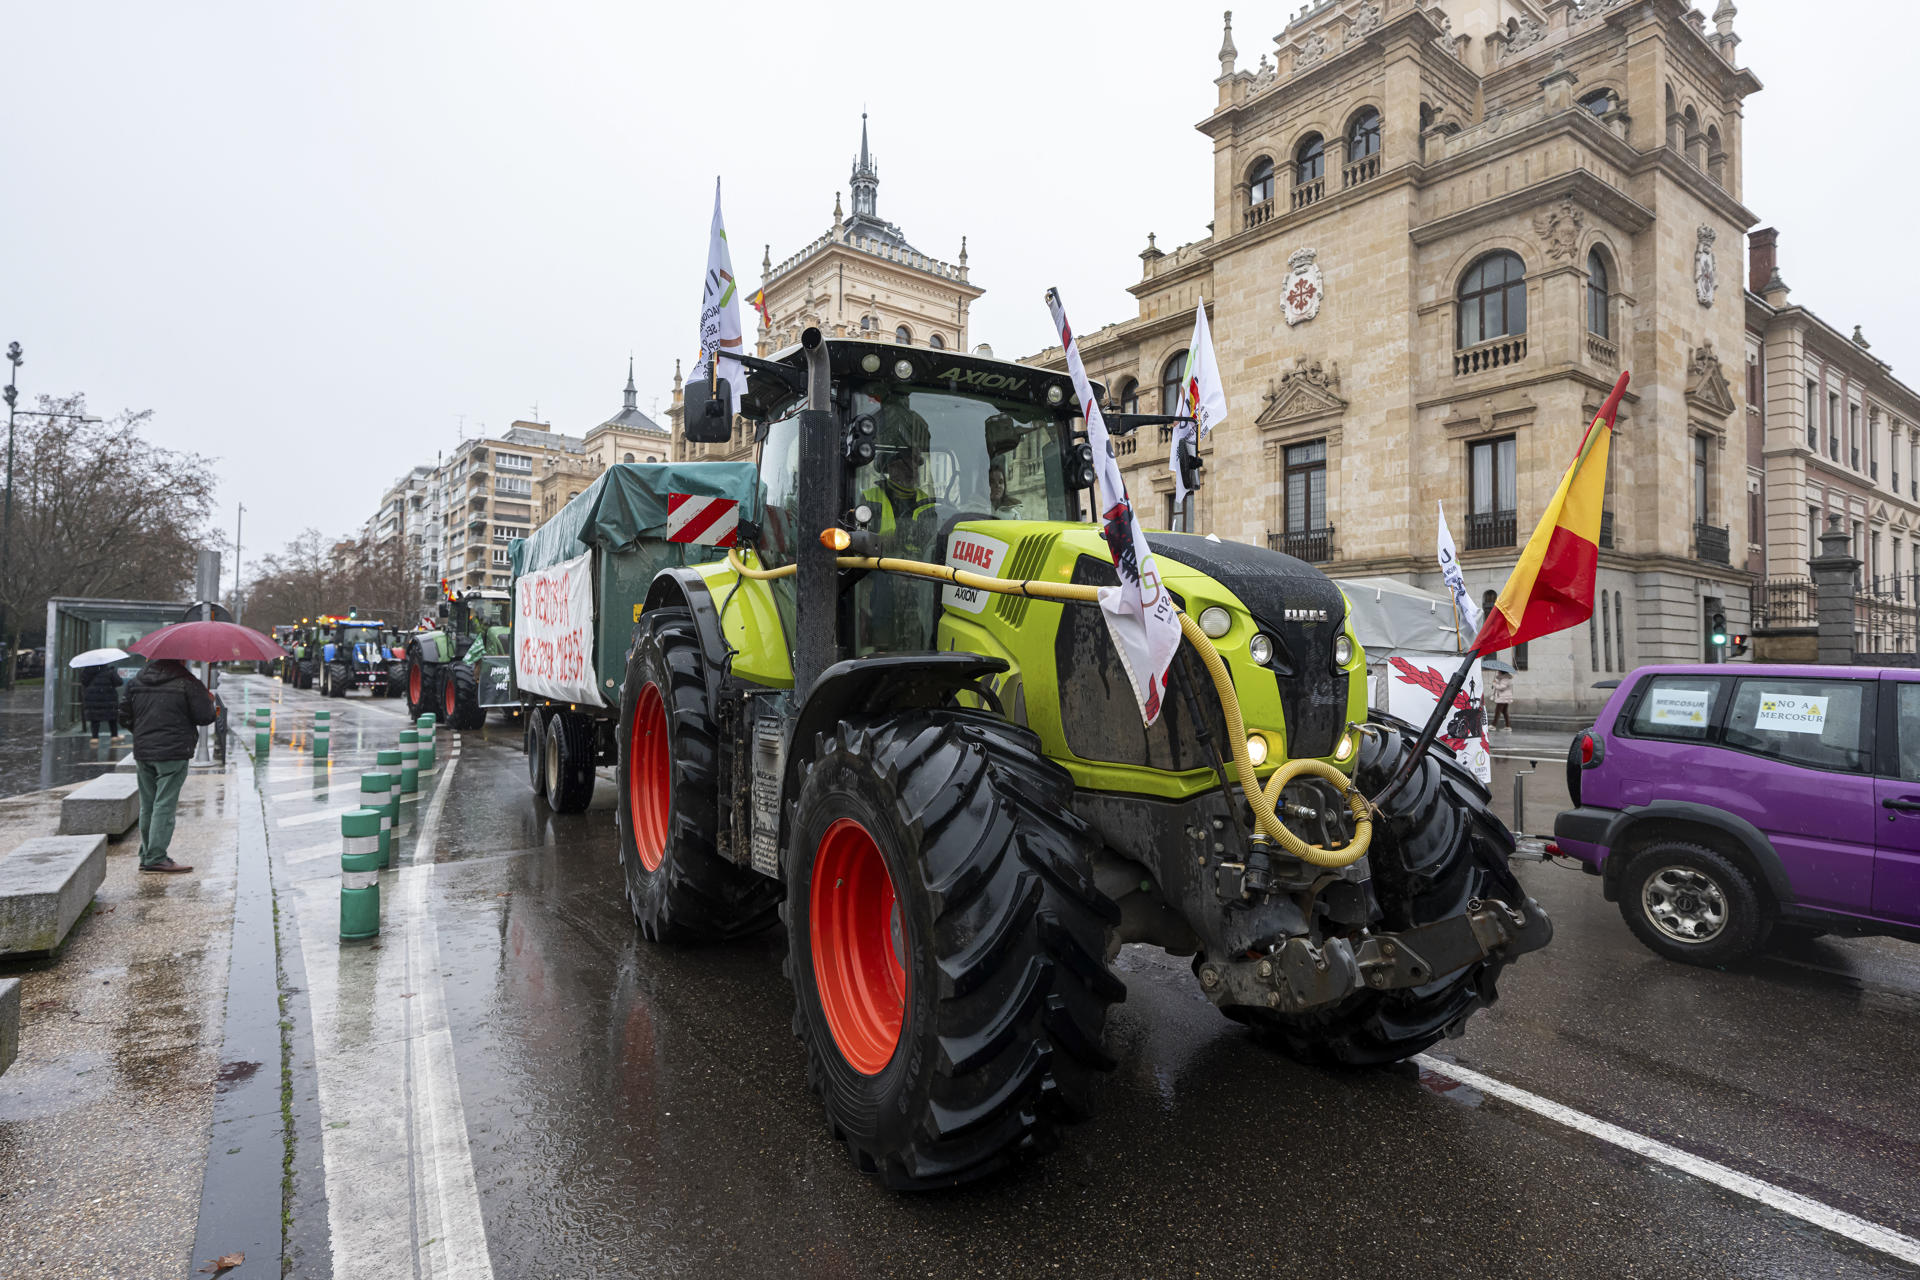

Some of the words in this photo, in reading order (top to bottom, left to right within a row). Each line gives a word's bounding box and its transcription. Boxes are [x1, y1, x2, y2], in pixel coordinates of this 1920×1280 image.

[937, 367, 1027, 391] AXION
[952, 540, 994, 570] CLAAS
[954, 587, 978, 603] AXION
[1284, 609, 1328, 622] CLAAS
[1656, 699, 1705, 708] MERCOSUR
[1777, 700, 1796, 708] NO
[1760, 711, 1823, 722] MERCOSUR
